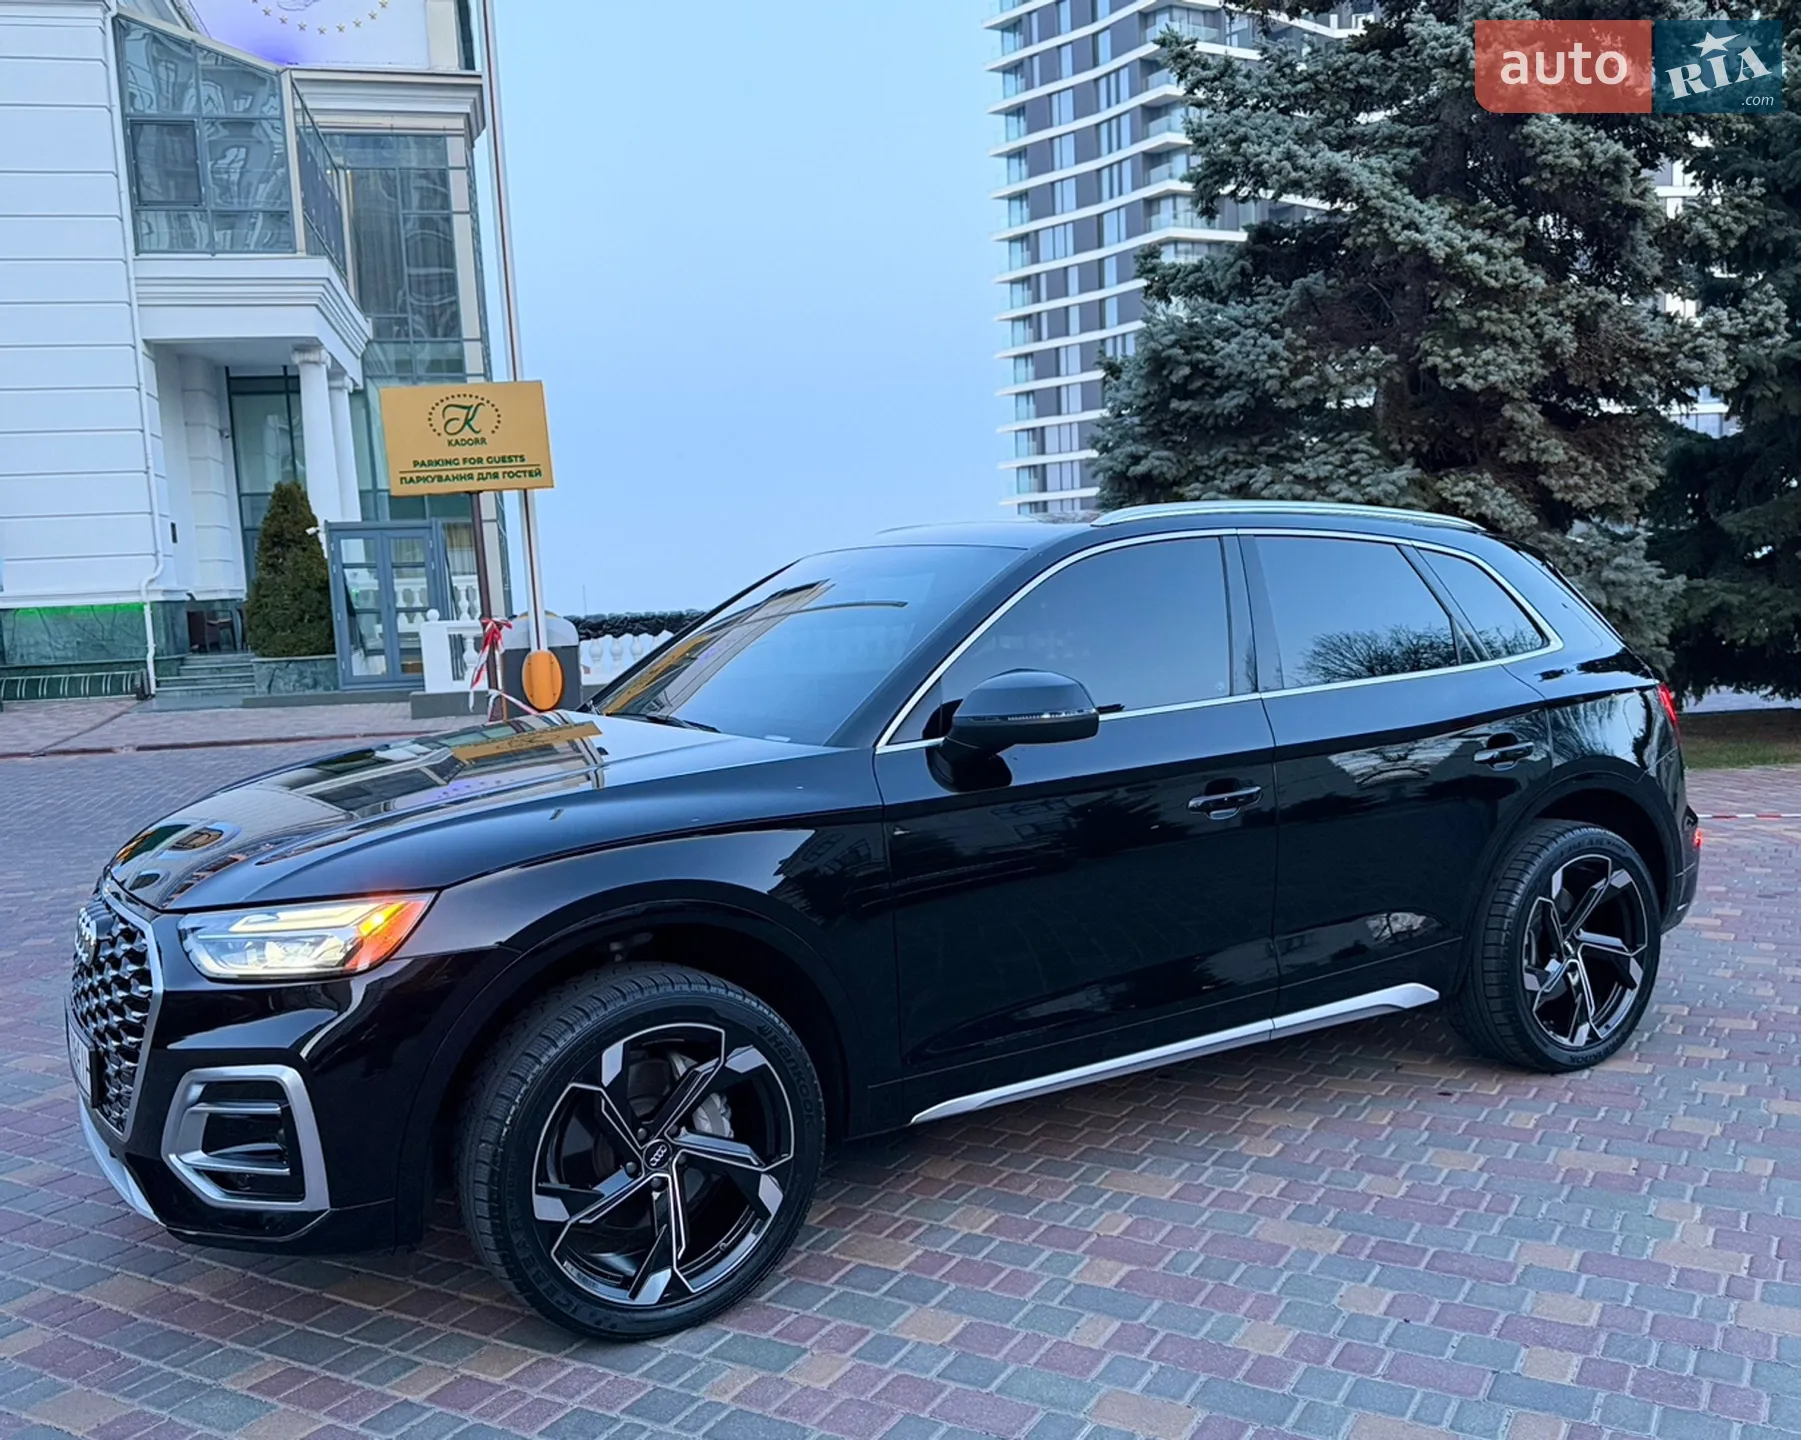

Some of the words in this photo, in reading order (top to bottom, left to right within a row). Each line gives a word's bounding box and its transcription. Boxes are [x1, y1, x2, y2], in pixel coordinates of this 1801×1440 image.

[447, 436, 488, 447] KADORR
[412, 457, 460, 469] PARKING
[462, 456, 484, 466] FOR
[486, 454, 526, 465] GUESTS
[399, 473, 474, 485] ПАРКУВАННЯ
[476, 471, 500, 482] ДЛЯ
[502, 467, 542, 480] ГОСТЕЙ
